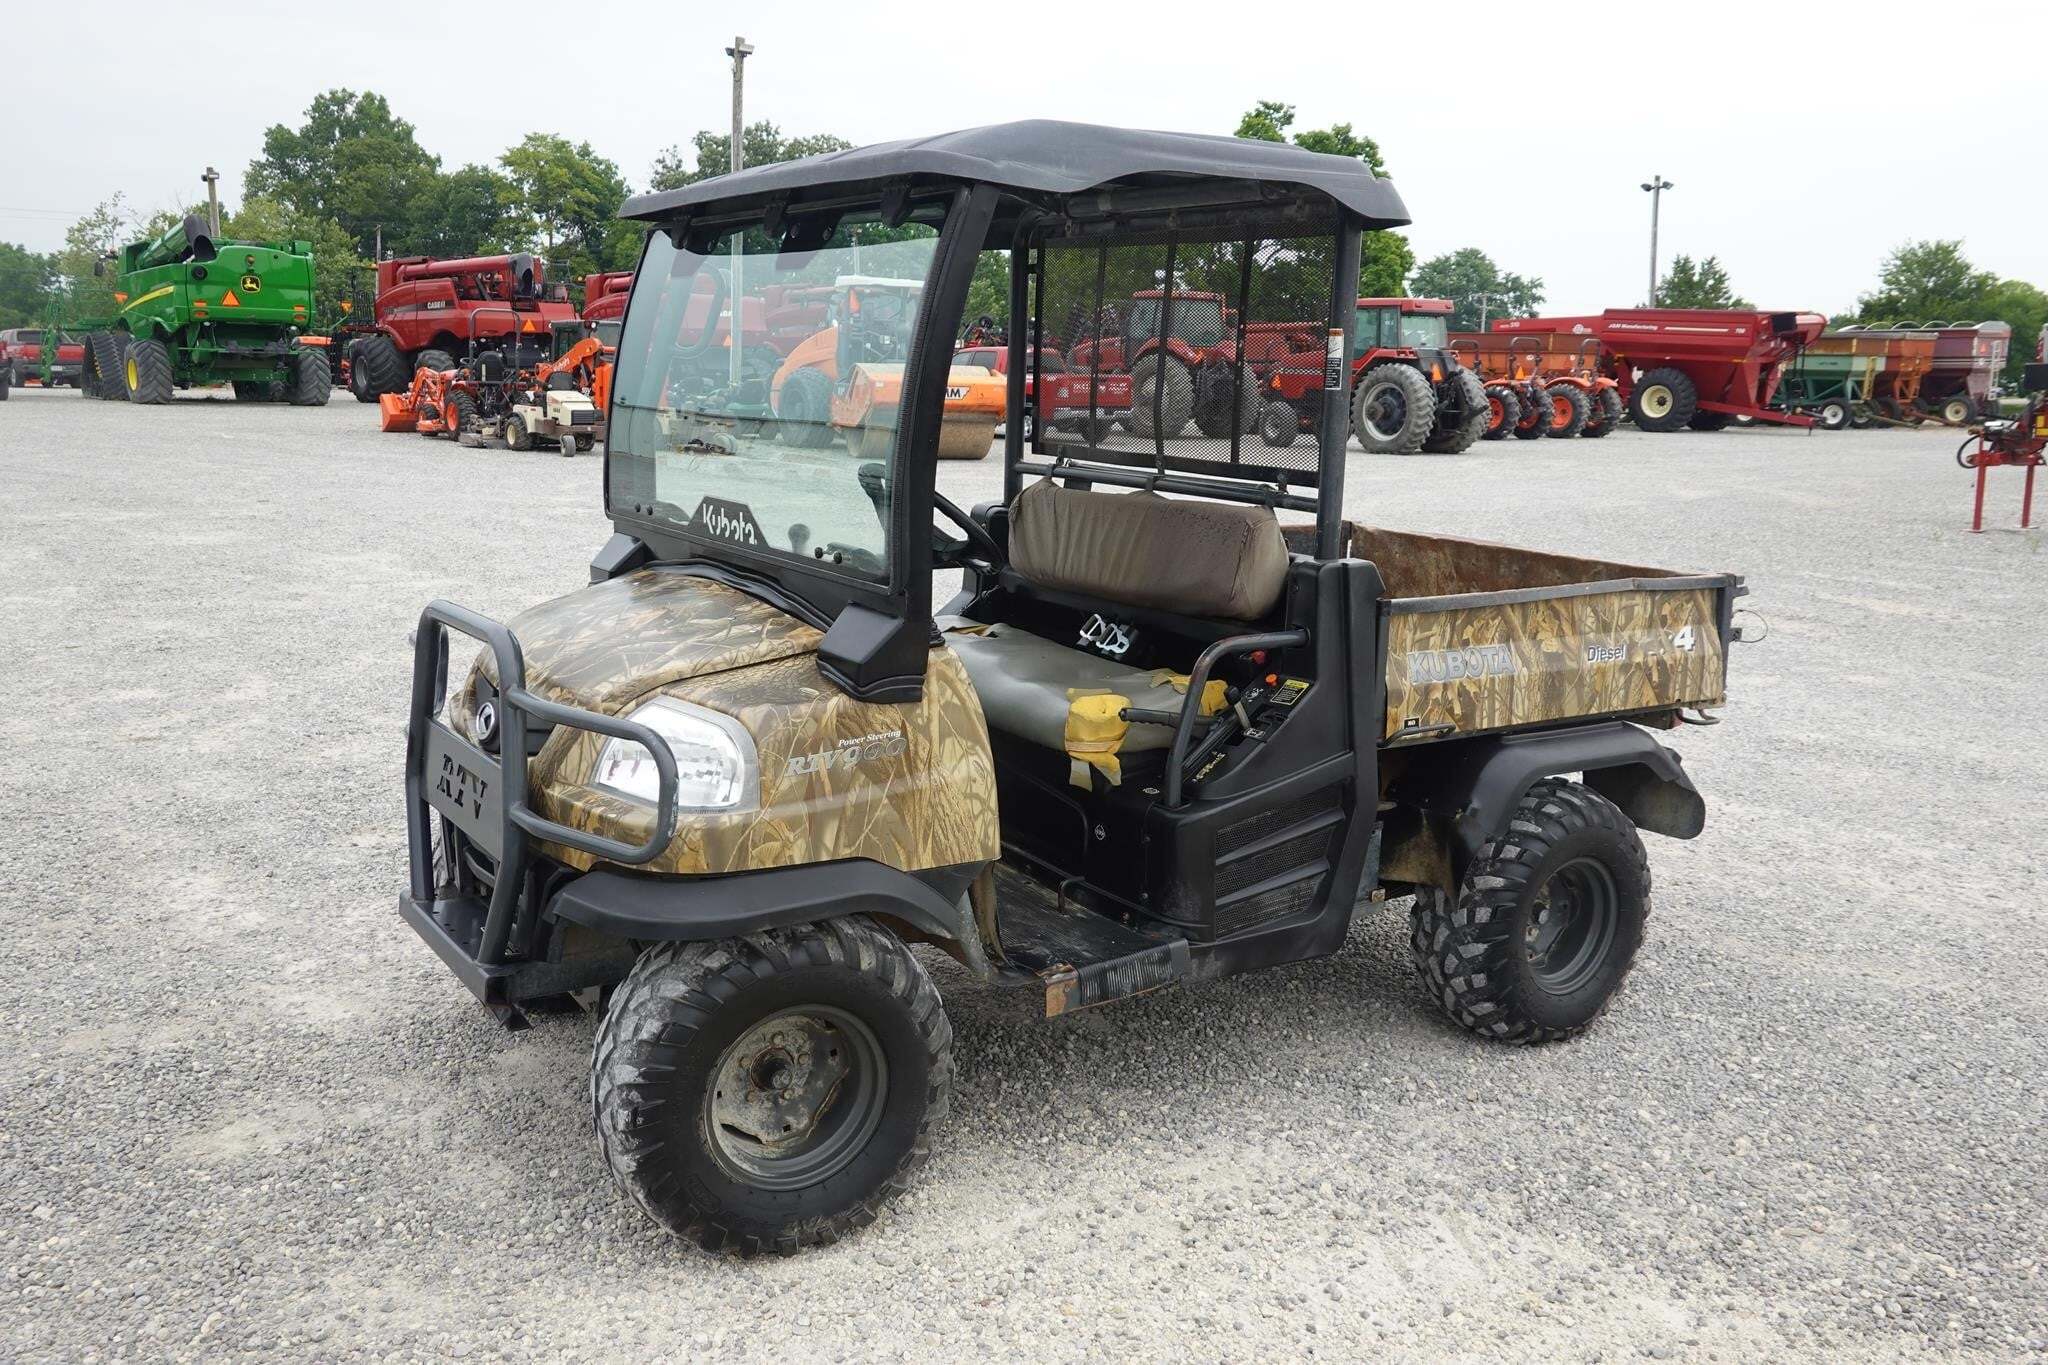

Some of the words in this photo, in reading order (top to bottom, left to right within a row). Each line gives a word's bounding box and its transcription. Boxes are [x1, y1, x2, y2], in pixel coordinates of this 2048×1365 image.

[427, 301, 440, 310] CASE
[702, 503, 755, 545] Kubota
[1407, 643, 1516, 685] KUBOTA
[1587, 643, 1627, 665] Diesel
[838, 737, 866, 747] Power
[867, 730, 901, 742] Steering
[436, 753, 488, 820] RTV
